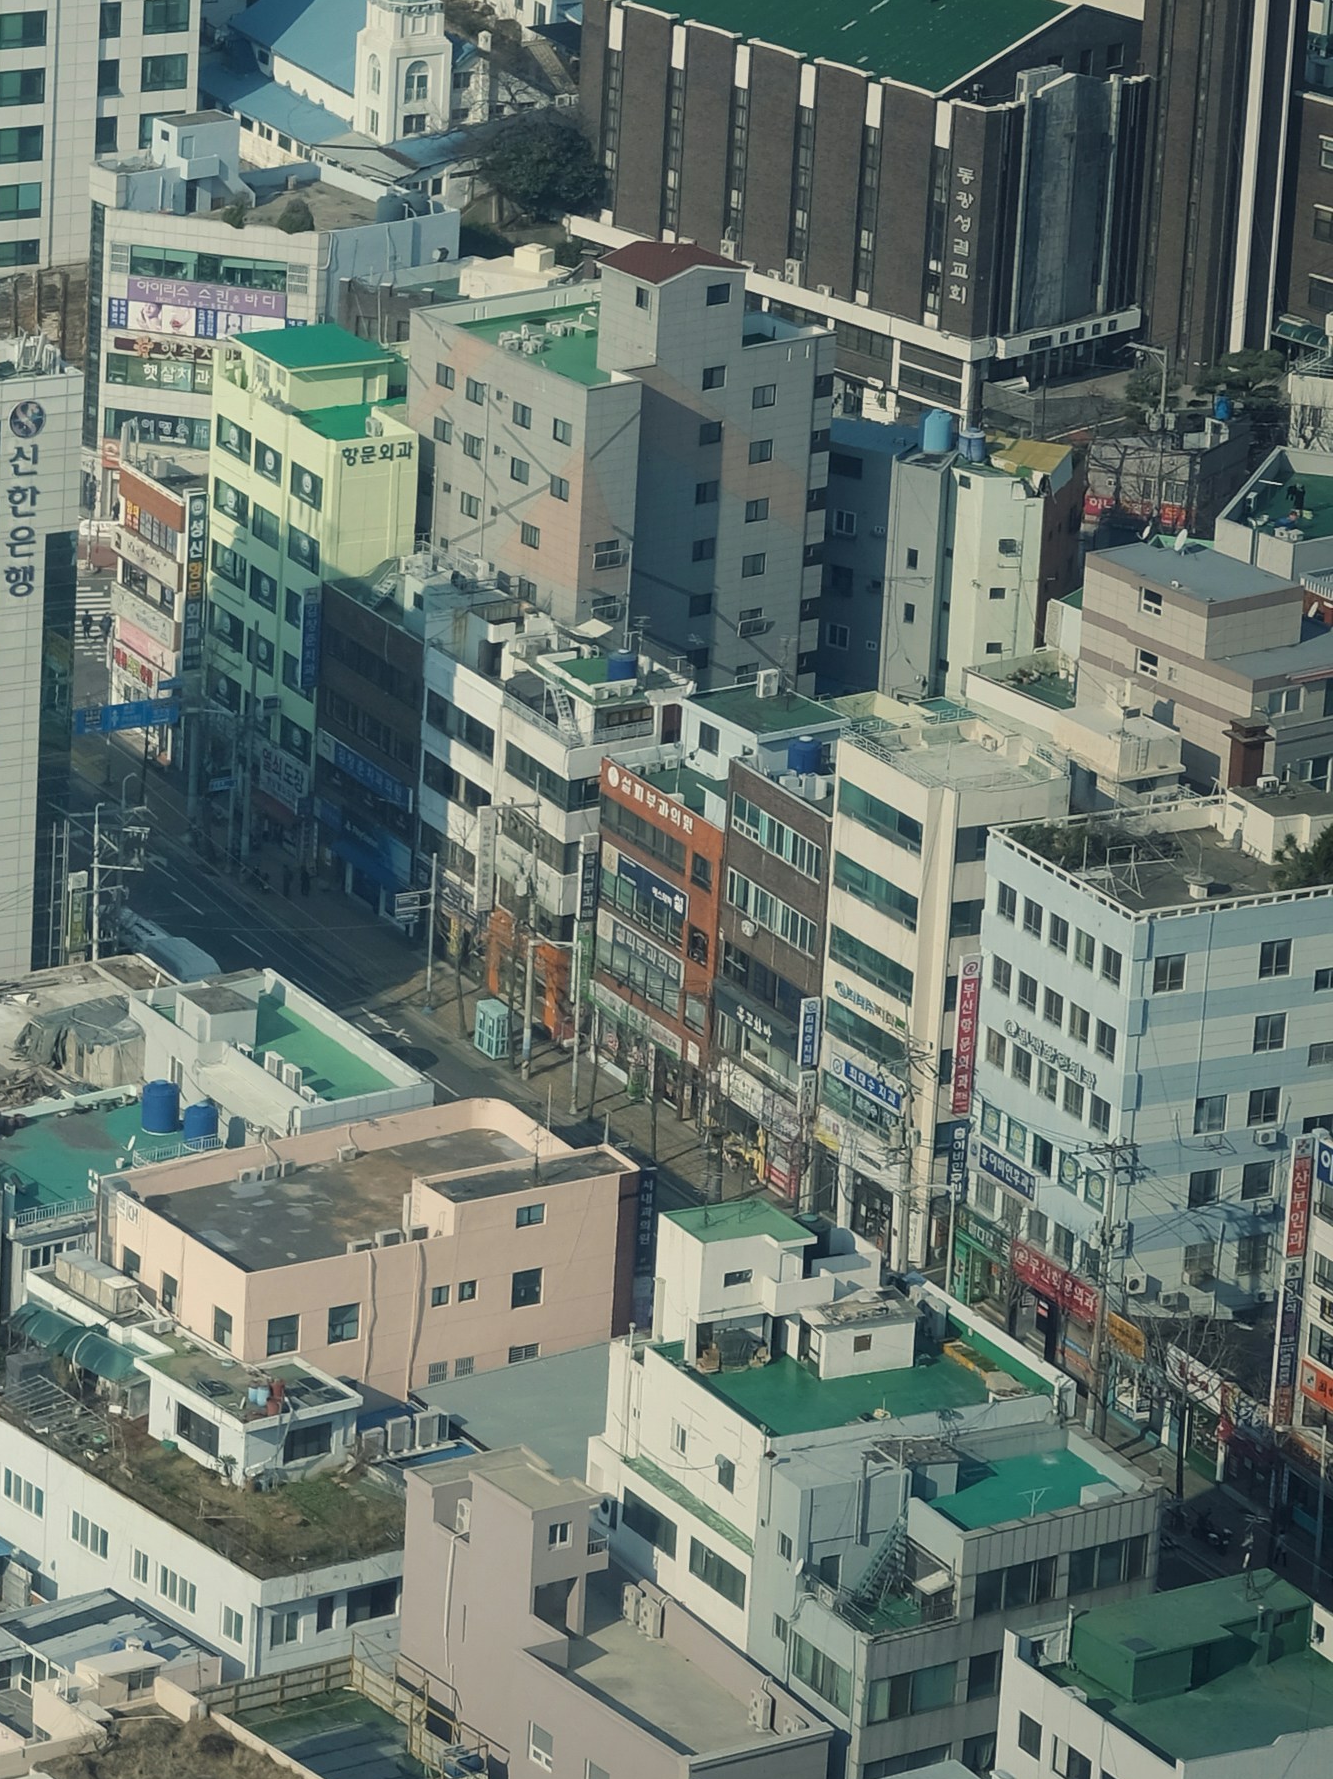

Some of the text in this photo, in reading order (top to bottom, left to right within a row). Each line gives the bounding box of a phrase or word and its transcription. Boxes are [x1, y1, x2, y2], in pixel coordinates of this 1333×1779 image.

[948, 166, 974, 305] 동광성결교회
[136, 279, 189, 298] 아이리스
[142, 363, 211, 385] 햇살치과
[341, 441, 414, 468] 항문외과
[4, 444, 41, 598] 신한은행
[620, 775, 694, 837] 설피부과의원
[954, 983, 976, 1090] 부산항문외과
